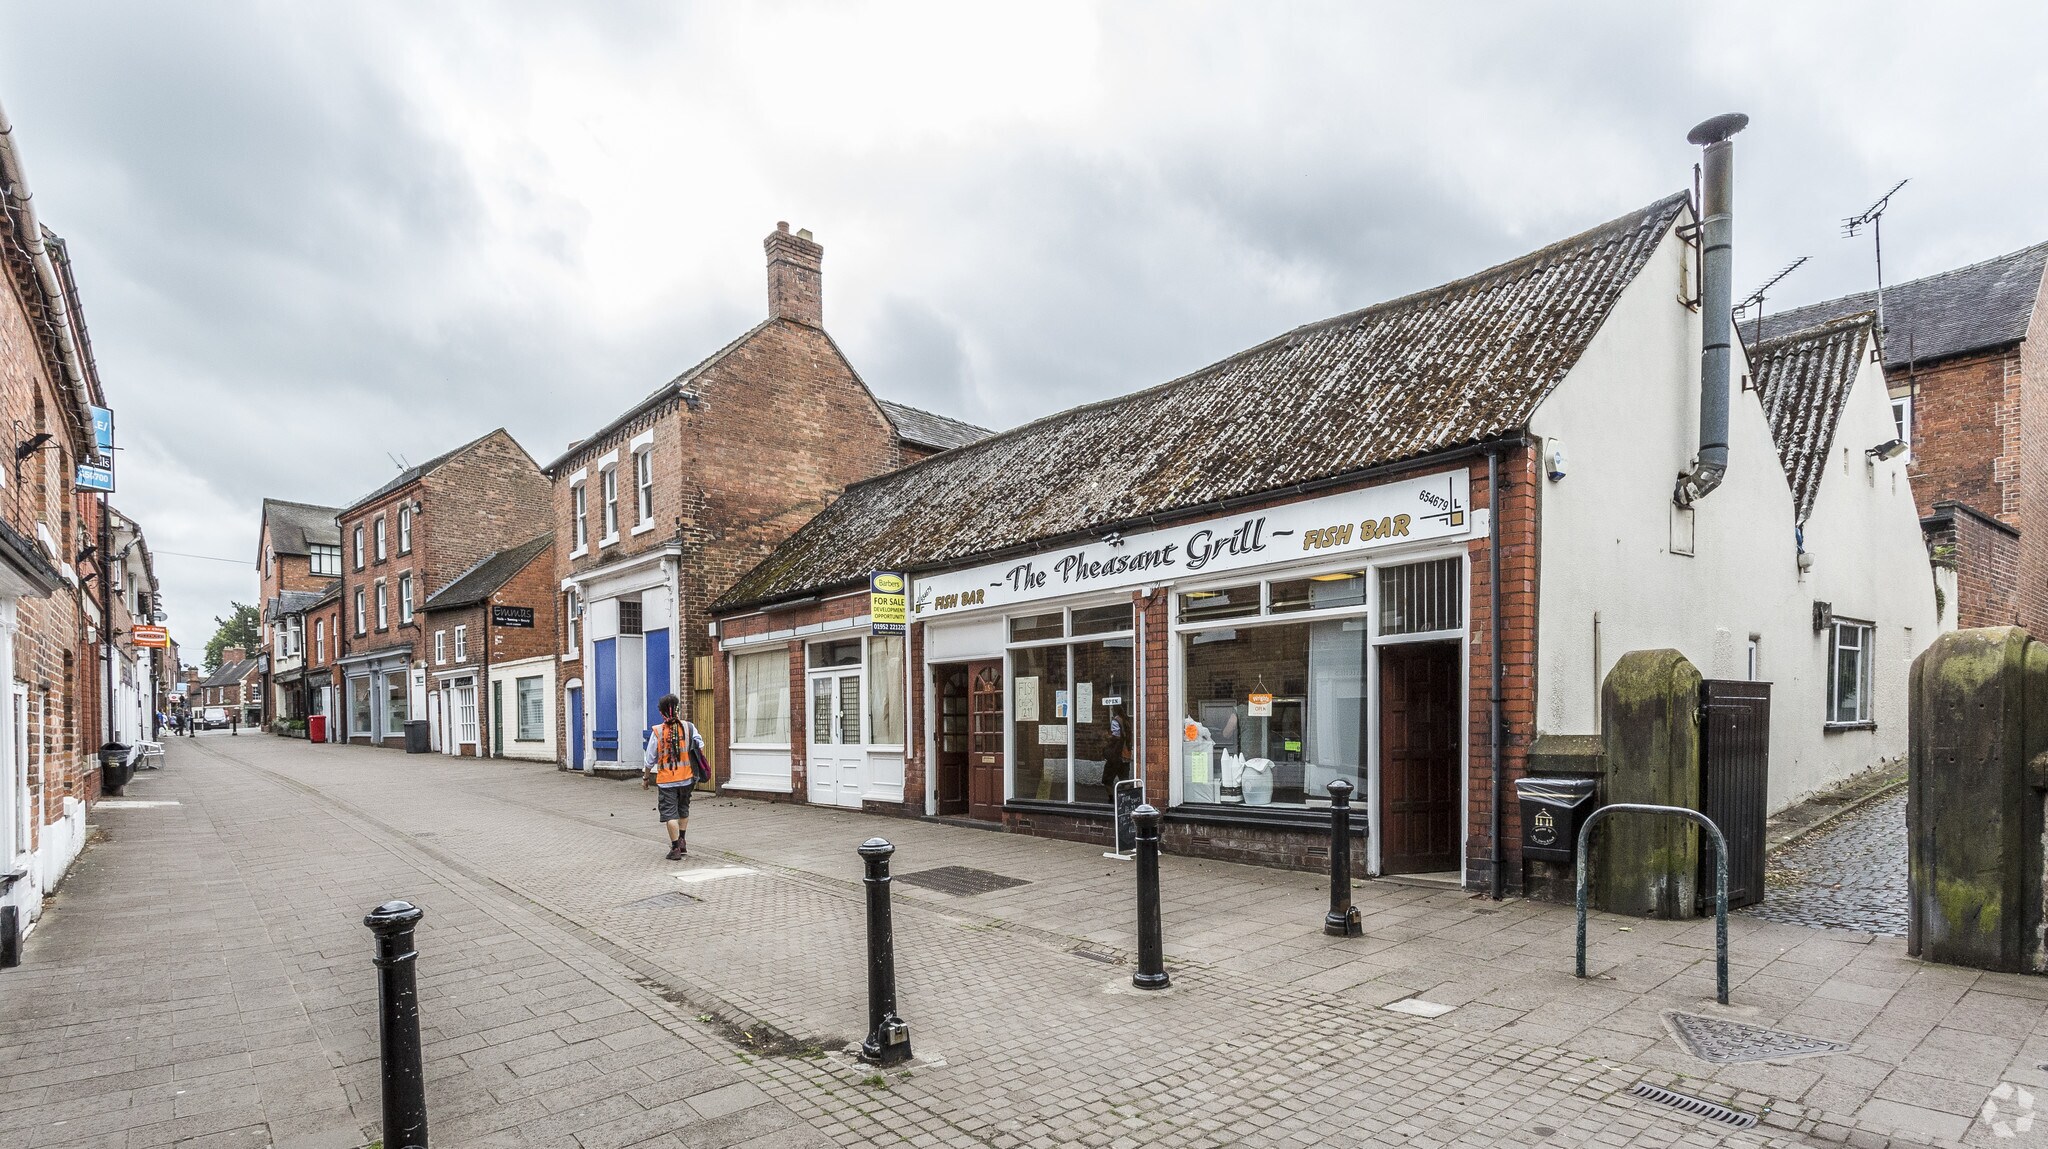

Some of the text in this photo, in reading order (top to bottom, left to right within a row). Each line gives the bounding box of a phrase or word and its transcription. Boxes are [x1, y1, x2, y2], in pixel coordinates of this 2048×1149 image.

[1419, 489, 1449, 511] 654679
[1303, 513, 1411, 551] FISH BAR
[1006, 516, 1267, 592] The Pheasant Grill
[878, 579, 900, 588] Barbers
[874, 597, 905, 606] FOR SALE
[934, 588, 985, 611] FISH BAR
